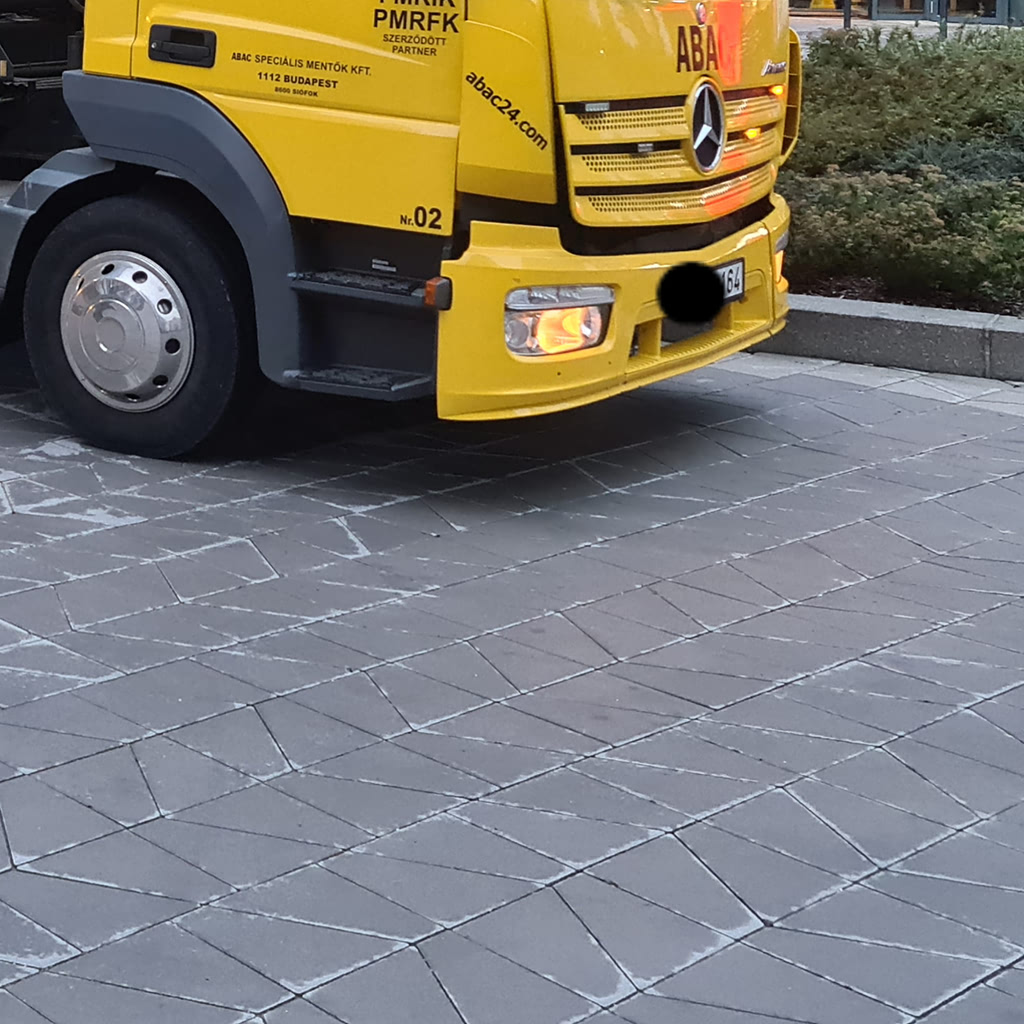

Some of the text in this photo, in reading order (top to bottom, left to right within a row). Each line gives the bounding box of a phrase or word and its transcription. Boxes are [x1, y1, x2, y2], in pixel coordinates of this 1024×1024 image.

[373, 8, 460, 34] PMRFK
[231, 52, 252, 63] ABAC
[254, 54, 304, 69] SPECIÁLIS
[392, 45, 438, 57] PARTNER
[257, 71, 339, 90] 1112 BUDAPEST
[465, 71, 549, 151] abac24.com
[399, 205, 443, 231] Nr. 02
